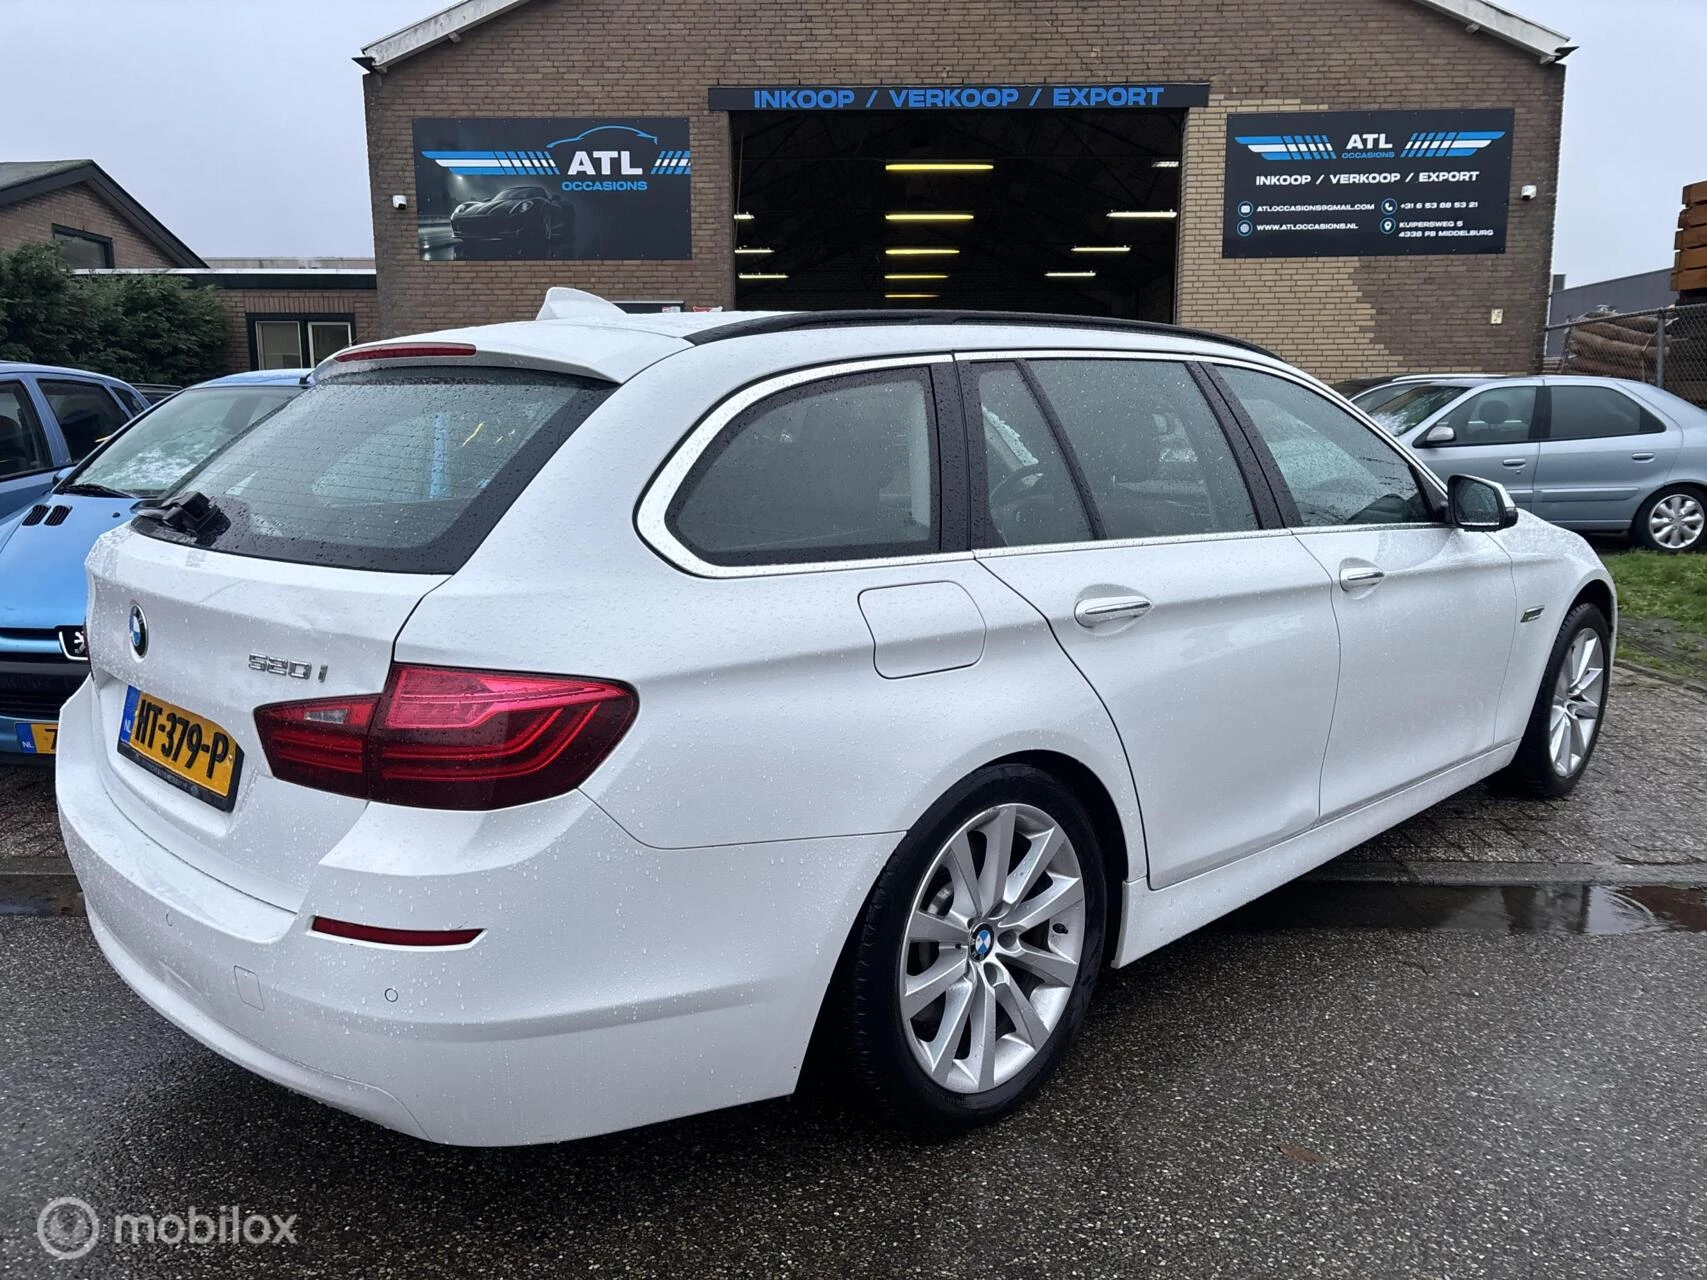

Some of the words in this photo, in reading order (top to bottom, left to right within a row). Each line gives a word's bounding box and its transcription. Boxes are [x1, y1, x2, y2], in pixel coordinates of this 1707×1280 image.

[753, 90, 855, 109] INKOOP
[865, 89, 879, 108] /
[888, 88, 1019, 108] VERKOOP
[1028, 88, 1043, 107] /
[1053, 87, 1165, 107] EXPORT
[1345, 133, 1393, 149] ATL
[1341, 151, 1395, 159] OCCASIONS
[567, 151, 643, 175] ATL
[1255, 175, 1312, 186] INKOOP
[1315, 174, 1325, 185] /
[1329, 173, 1401, 185] VERKOOP
[1405, 172, 1415, 183] /
[1418, 171, 1480, 182] EXPORT
[561, 181, 648, 191] OCCASIONS
[1256, 222, 1359, 231] WWW.ATLOCCASIONS.NL
[1438, 229, 1494, 237] MIDDELBURG
[22, 741, 35, 749] NL
[134, 698, 229, 780] HT-379-P
